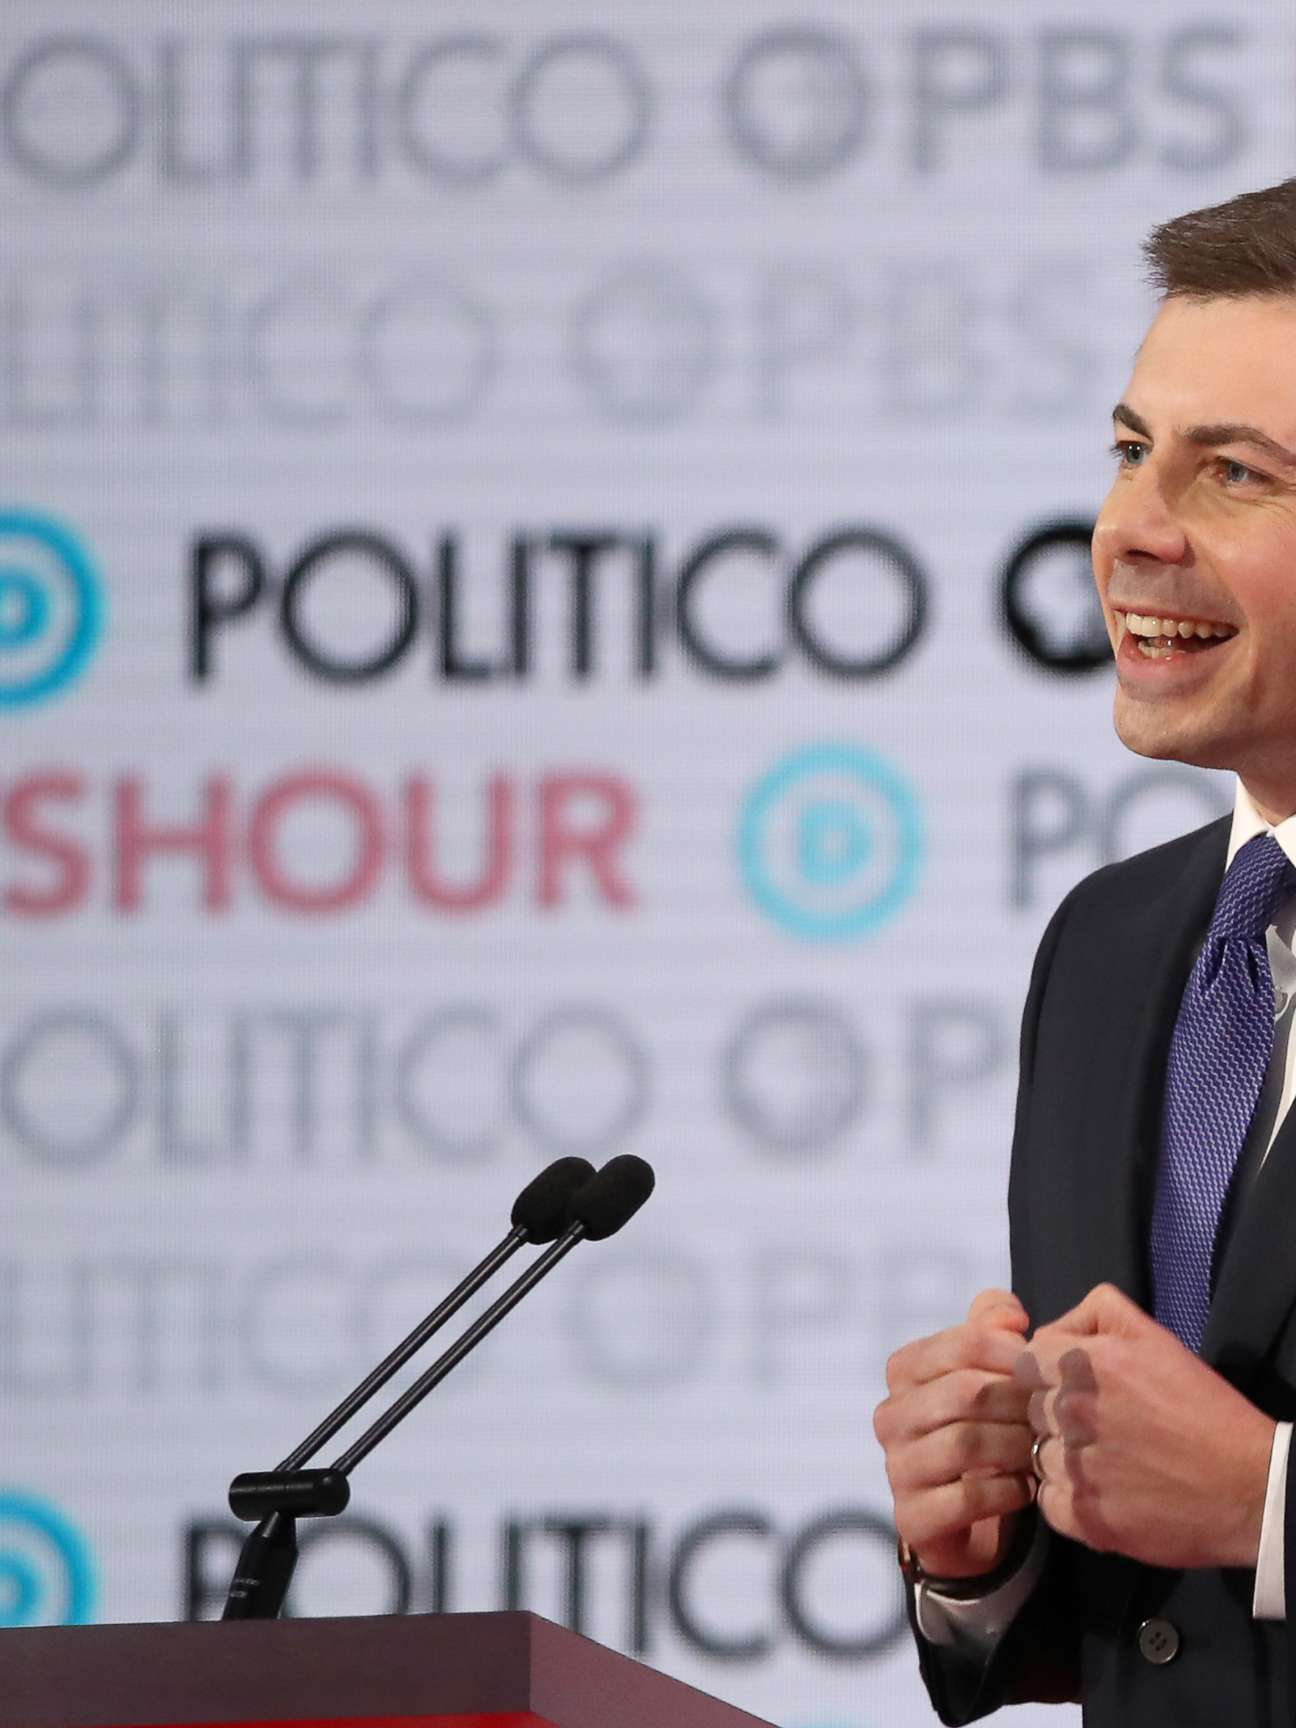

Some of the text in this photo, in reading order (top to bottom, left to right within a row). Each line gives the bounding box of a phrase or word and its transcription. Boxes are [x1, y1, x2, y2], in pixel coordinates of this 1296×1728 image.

[907, 22, 1250, 178] PBS
[186, 524, 933, 689] POLITICO
[0, 768, 640, 918] SHOUR
